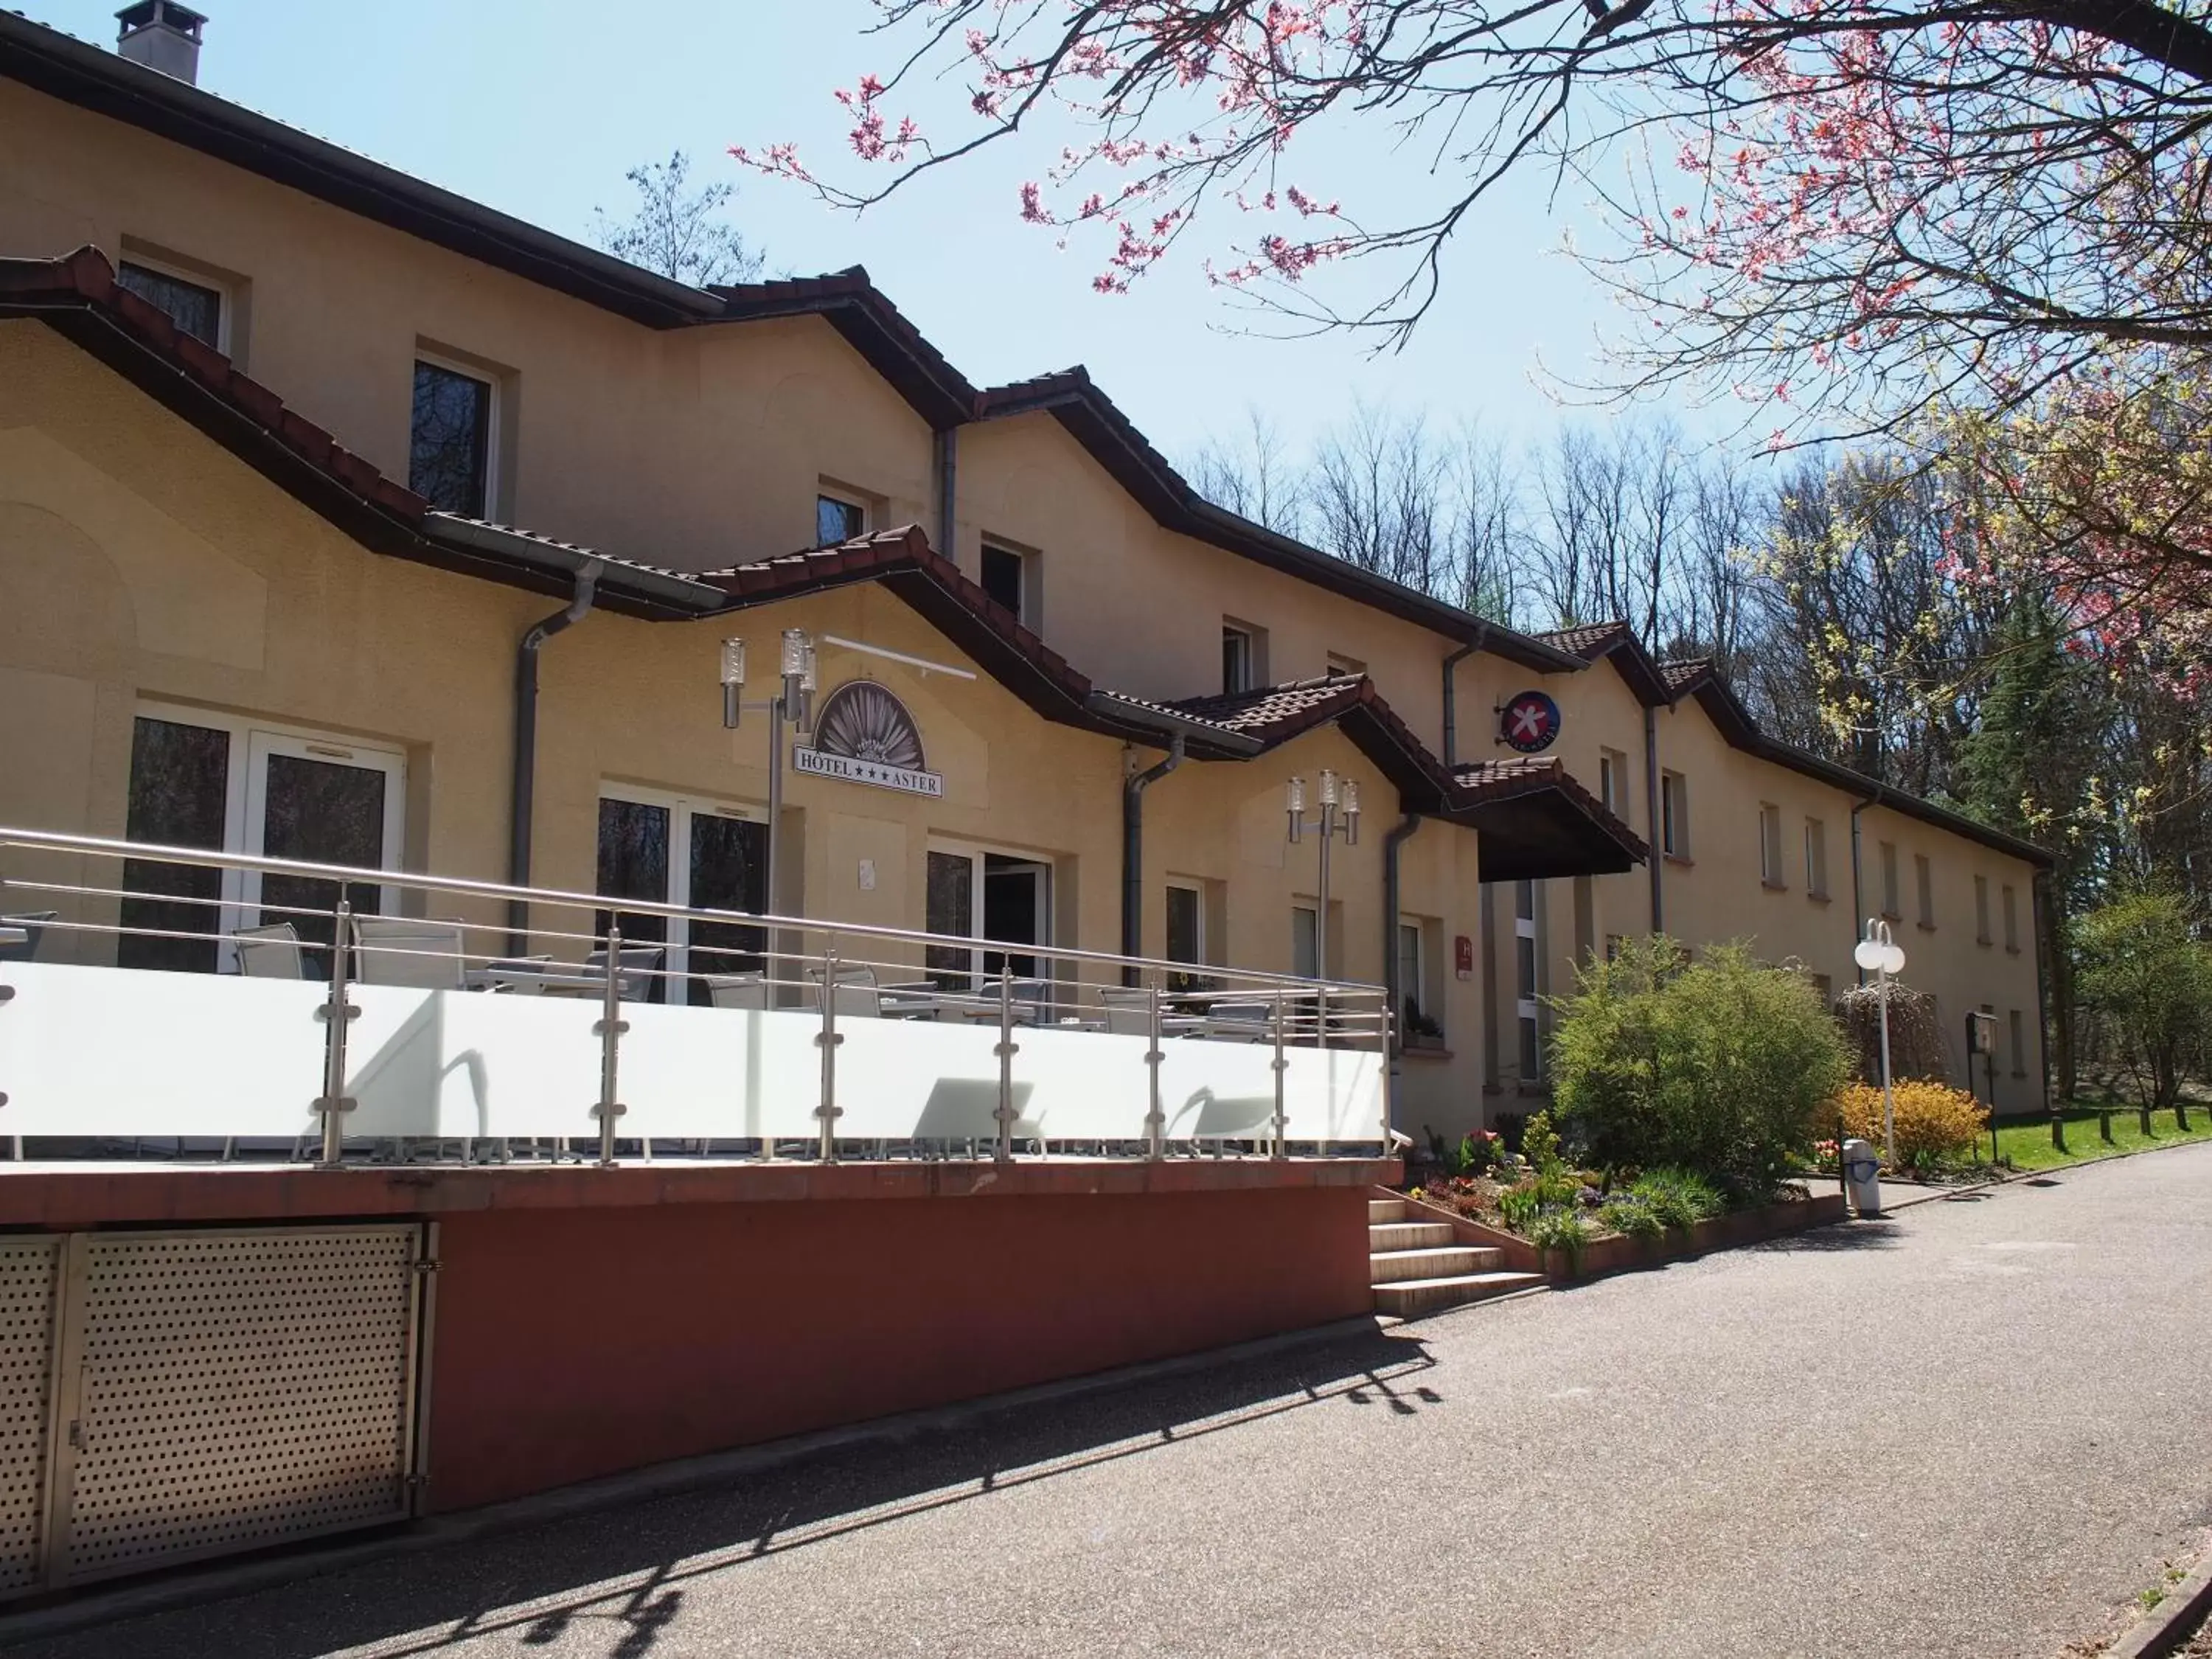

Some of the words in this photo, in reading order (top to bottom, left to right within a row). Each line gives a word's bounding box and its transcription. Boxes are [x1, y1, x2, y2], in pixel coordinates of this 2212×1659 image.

[801, 751, 852, 776] HÔTEL
[893, 773, 936, 792] ASTER
[1464, 942, 1471, 957] H
